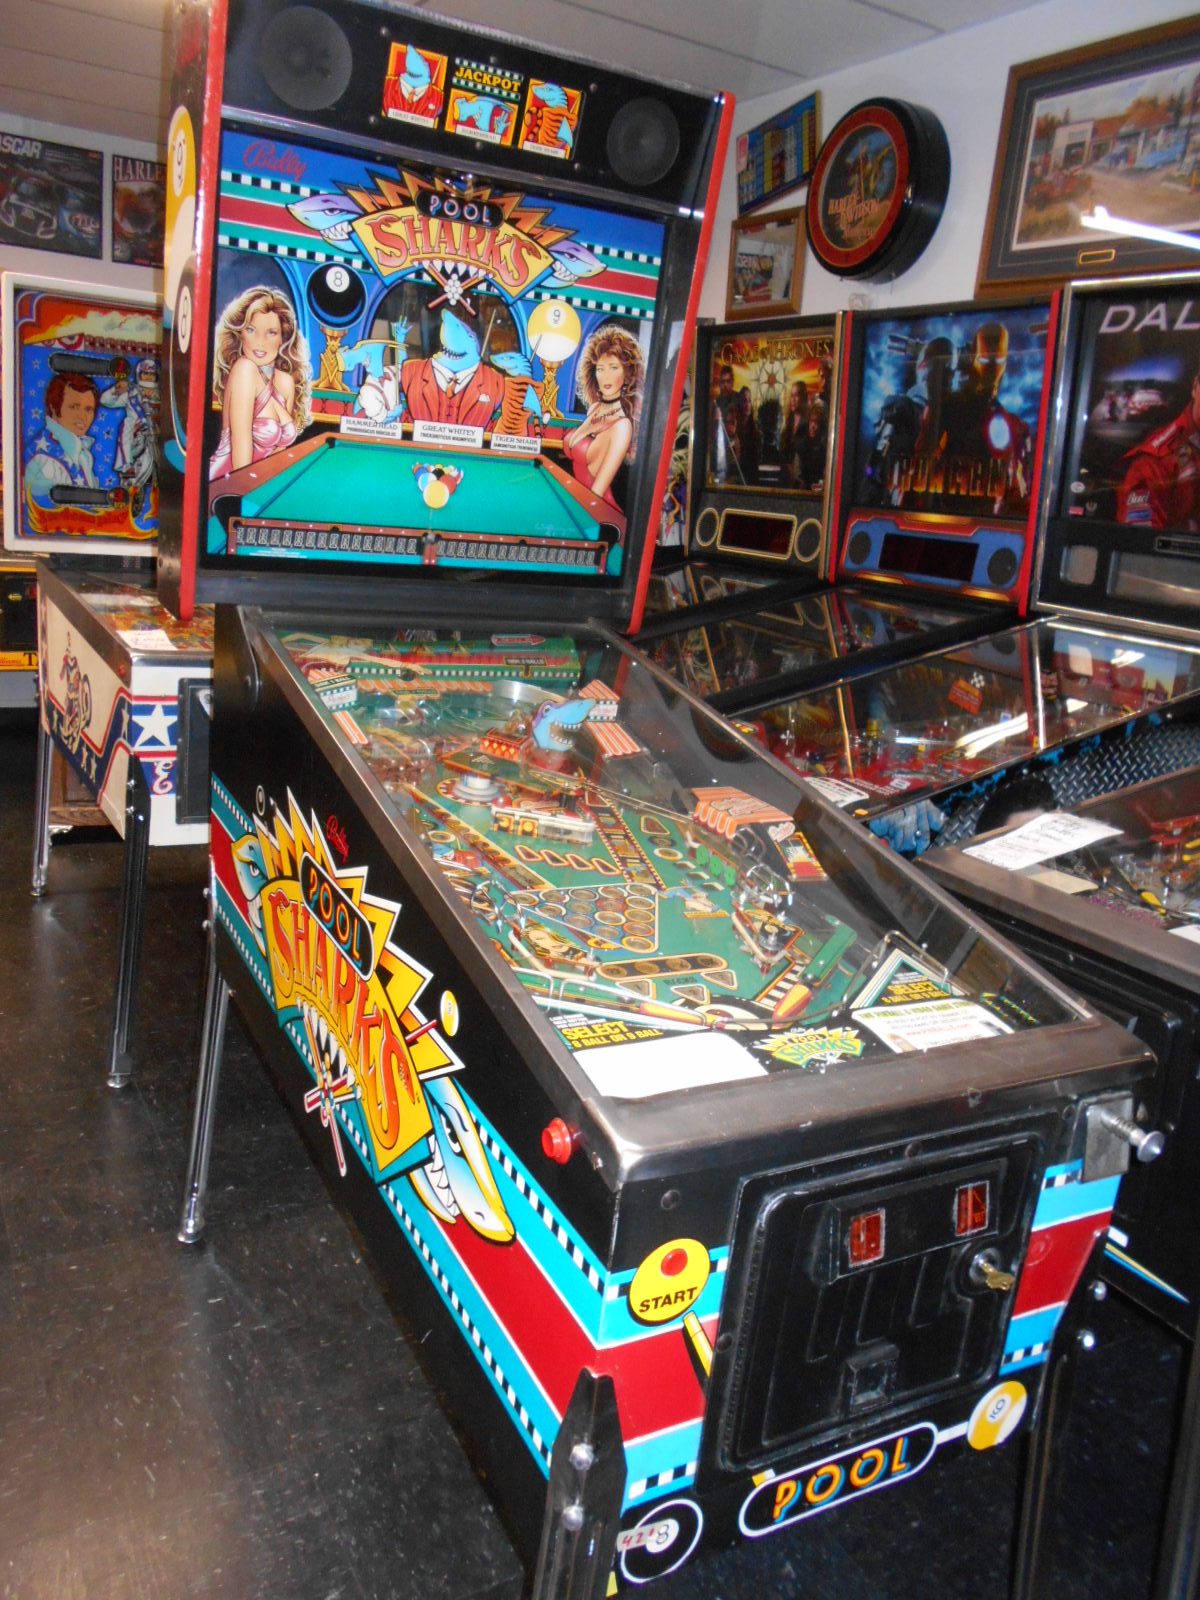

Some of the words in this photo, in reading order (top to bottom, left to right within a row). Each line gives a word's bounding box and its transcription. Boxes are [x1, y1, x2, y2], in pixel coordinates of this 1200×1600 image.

[455, 67, 521, 92] JACKPOT
[0, 135, 42, 160] SCAR
[243, 140, 307, 184] Bally
[430, 197, 491, 224] POOL
[365, 214, 541, 288] SHARKS
[422, 424, 447, 433] GREAT
[448, 428, 476, 437] WHITEY
[308, 867, 363, 968] POOL
[268, 888, 417, 1151] SHARKS
[562, 1020, 629, 1041] SELECT
[571, 1040, 582, 1049] 8
[581, 1036, 612, 1047] BALL
[609, 1033, 627, 1043] OR
[625, 1032, 637, 1041] 9
[634, 1028, 664, 1039] BALL
[639, 1286, 698, 1313] START
[773, 1437, 912, 1524] POOL
[656, 1524, 670, 1546] 8
